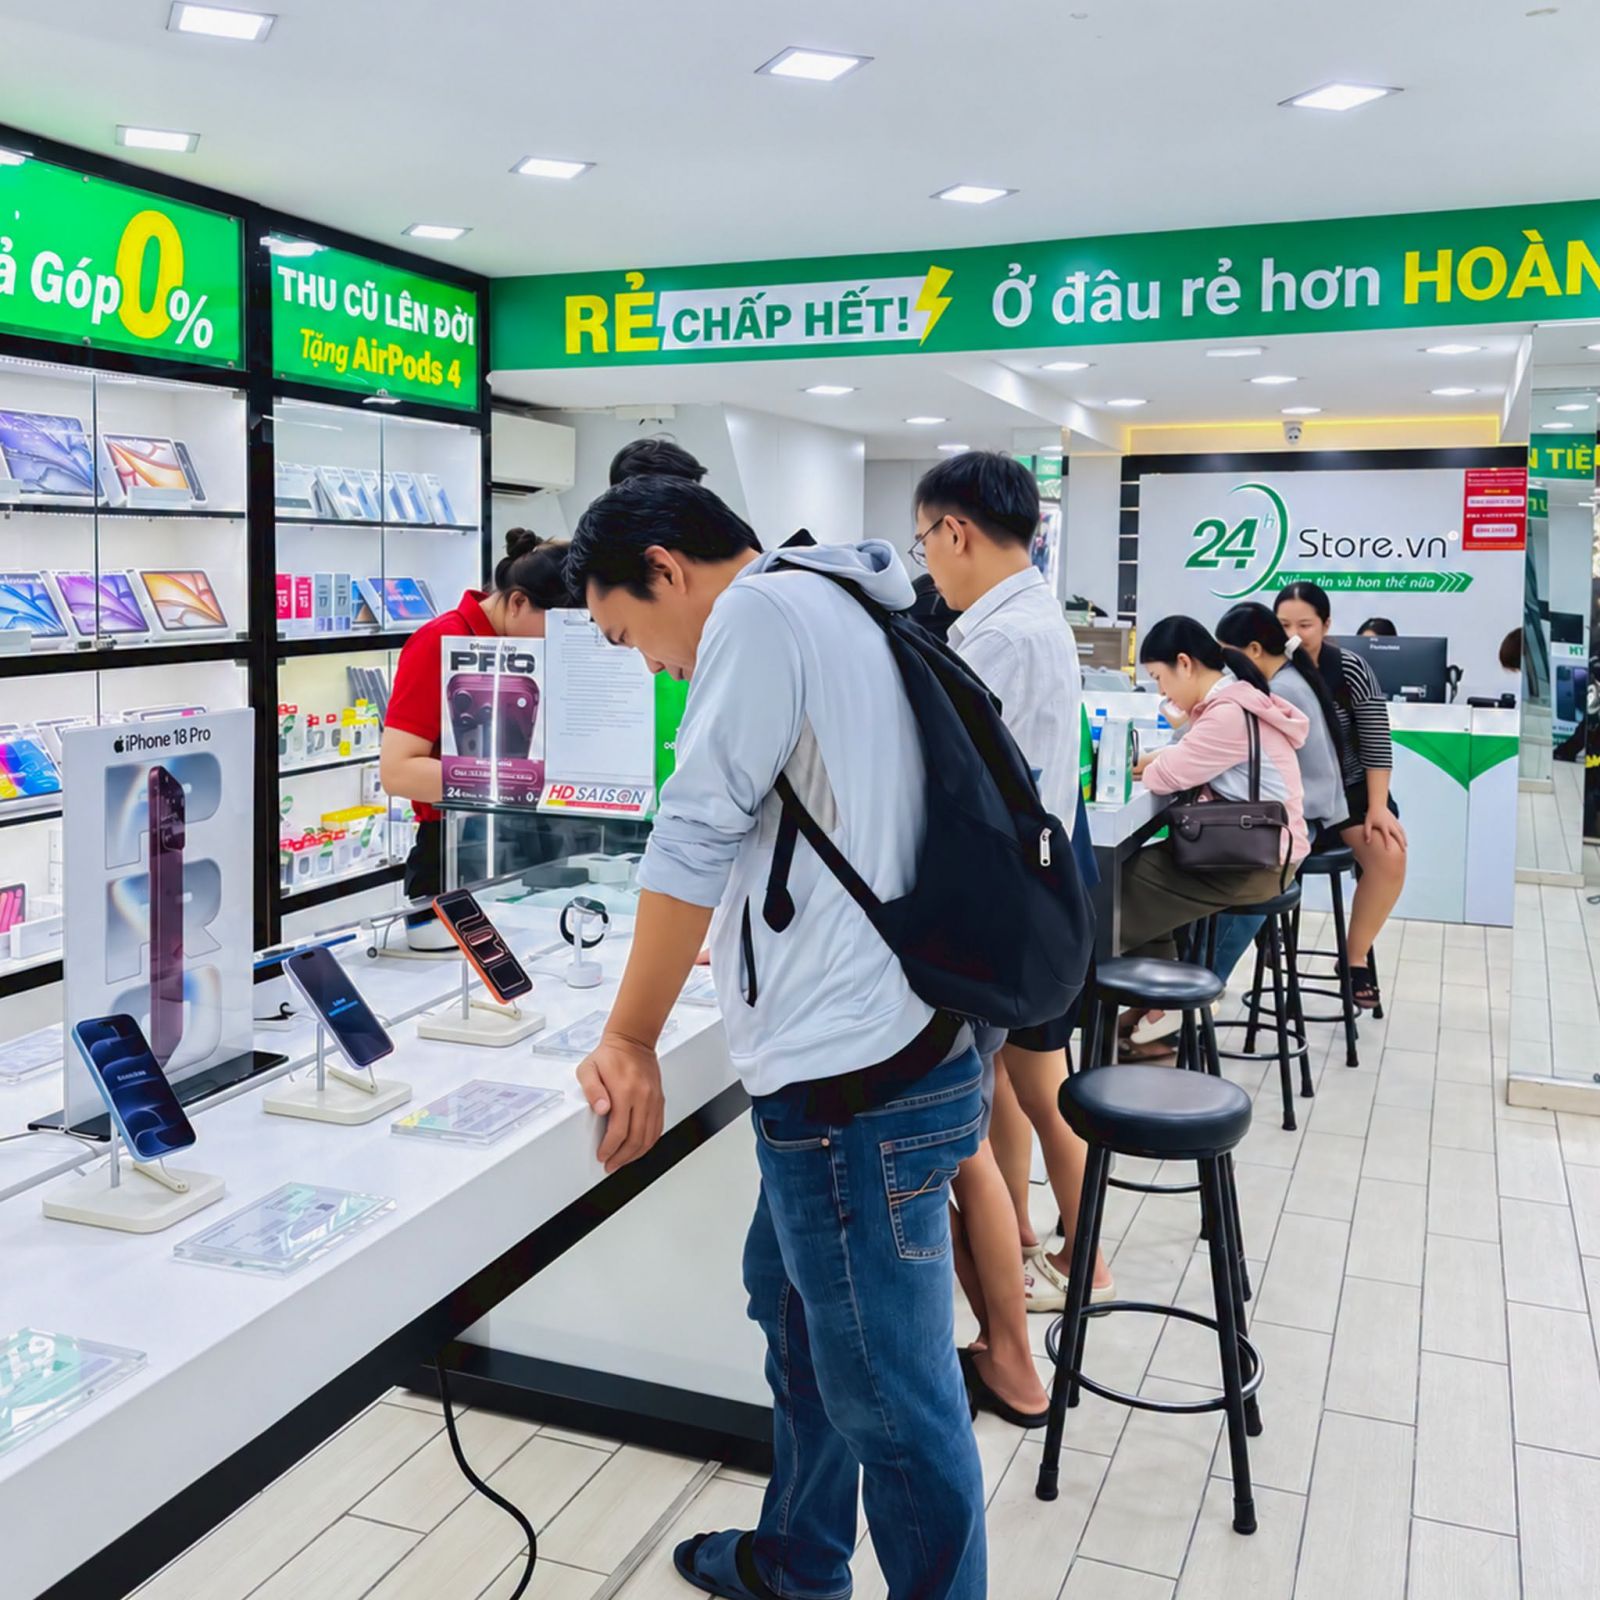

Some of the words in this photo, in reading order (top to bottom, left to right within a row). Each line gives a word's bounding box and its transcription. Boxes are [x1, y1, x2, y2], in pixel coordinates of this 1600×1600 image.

[30, 250, 121, 325] Góp
[992, 262, 1037, 327] Ở
[1051, 270, 1161, 325] đâu
[1181, 257, 1240, 317] rẻ
[1261, 257, 1380, 313] hơn
[1404, 229, 1600, 305] HOÀN
[277, 265, 337, 311] THU
[344, 280, 378, 321] CŨ
[385, 289, 429, 335] LÊN
[434, 305, 474, 345] ĐỜI
[565, 272, 660, 354] RẺ
[671, 291, 792, 343] CHẤP
[804, 285, 909, 337] HẾT!
[300, 328, 349, 373] Tặng
[352, 336, 443, 386] AirPods
[447, 359, 461, 389] 4
[1185, 518, 1259, 569] 24
[1299, 529, 1447, 558] Store.vn
[1337, 575, 1352, 587] và
[126, 734, 171, 751] iPhone
[174, 729, 187, 744] 18
[190, 727, 211, 743] Pro
[447, 787, 460, 798] 24
[549, 784, 575, 799] HD
